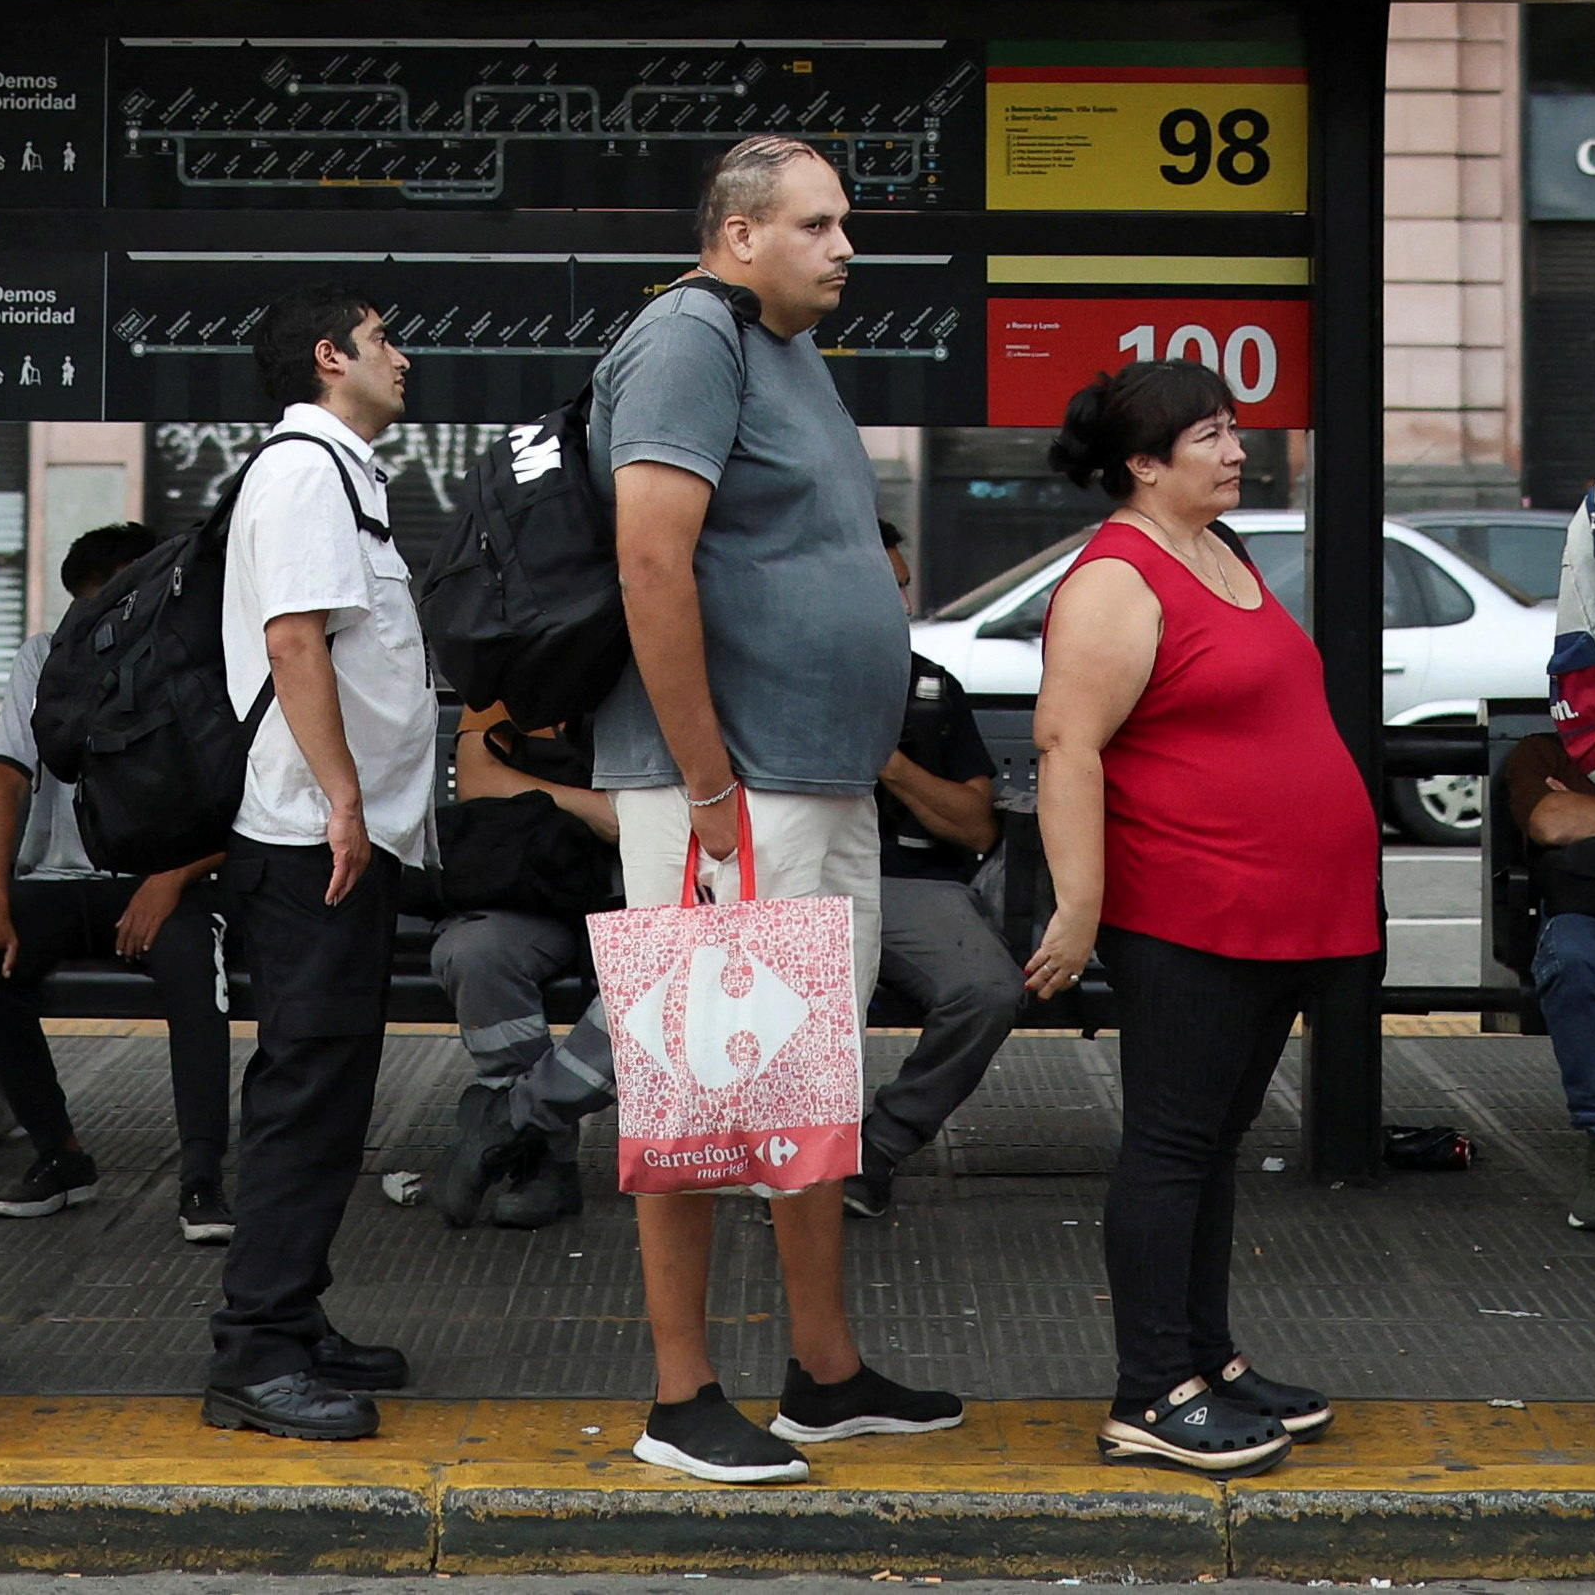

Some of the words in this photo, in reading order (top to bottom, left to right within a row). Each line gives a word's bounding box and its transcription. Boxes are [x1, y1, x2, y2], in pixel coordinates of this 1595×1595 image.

[1157, 107, 1271, 186] 98
[1118, 324, 1278, 404] 100
[643, 1143, 748, 1168] Carrefour
[697, 1157, 750, 1179] market
